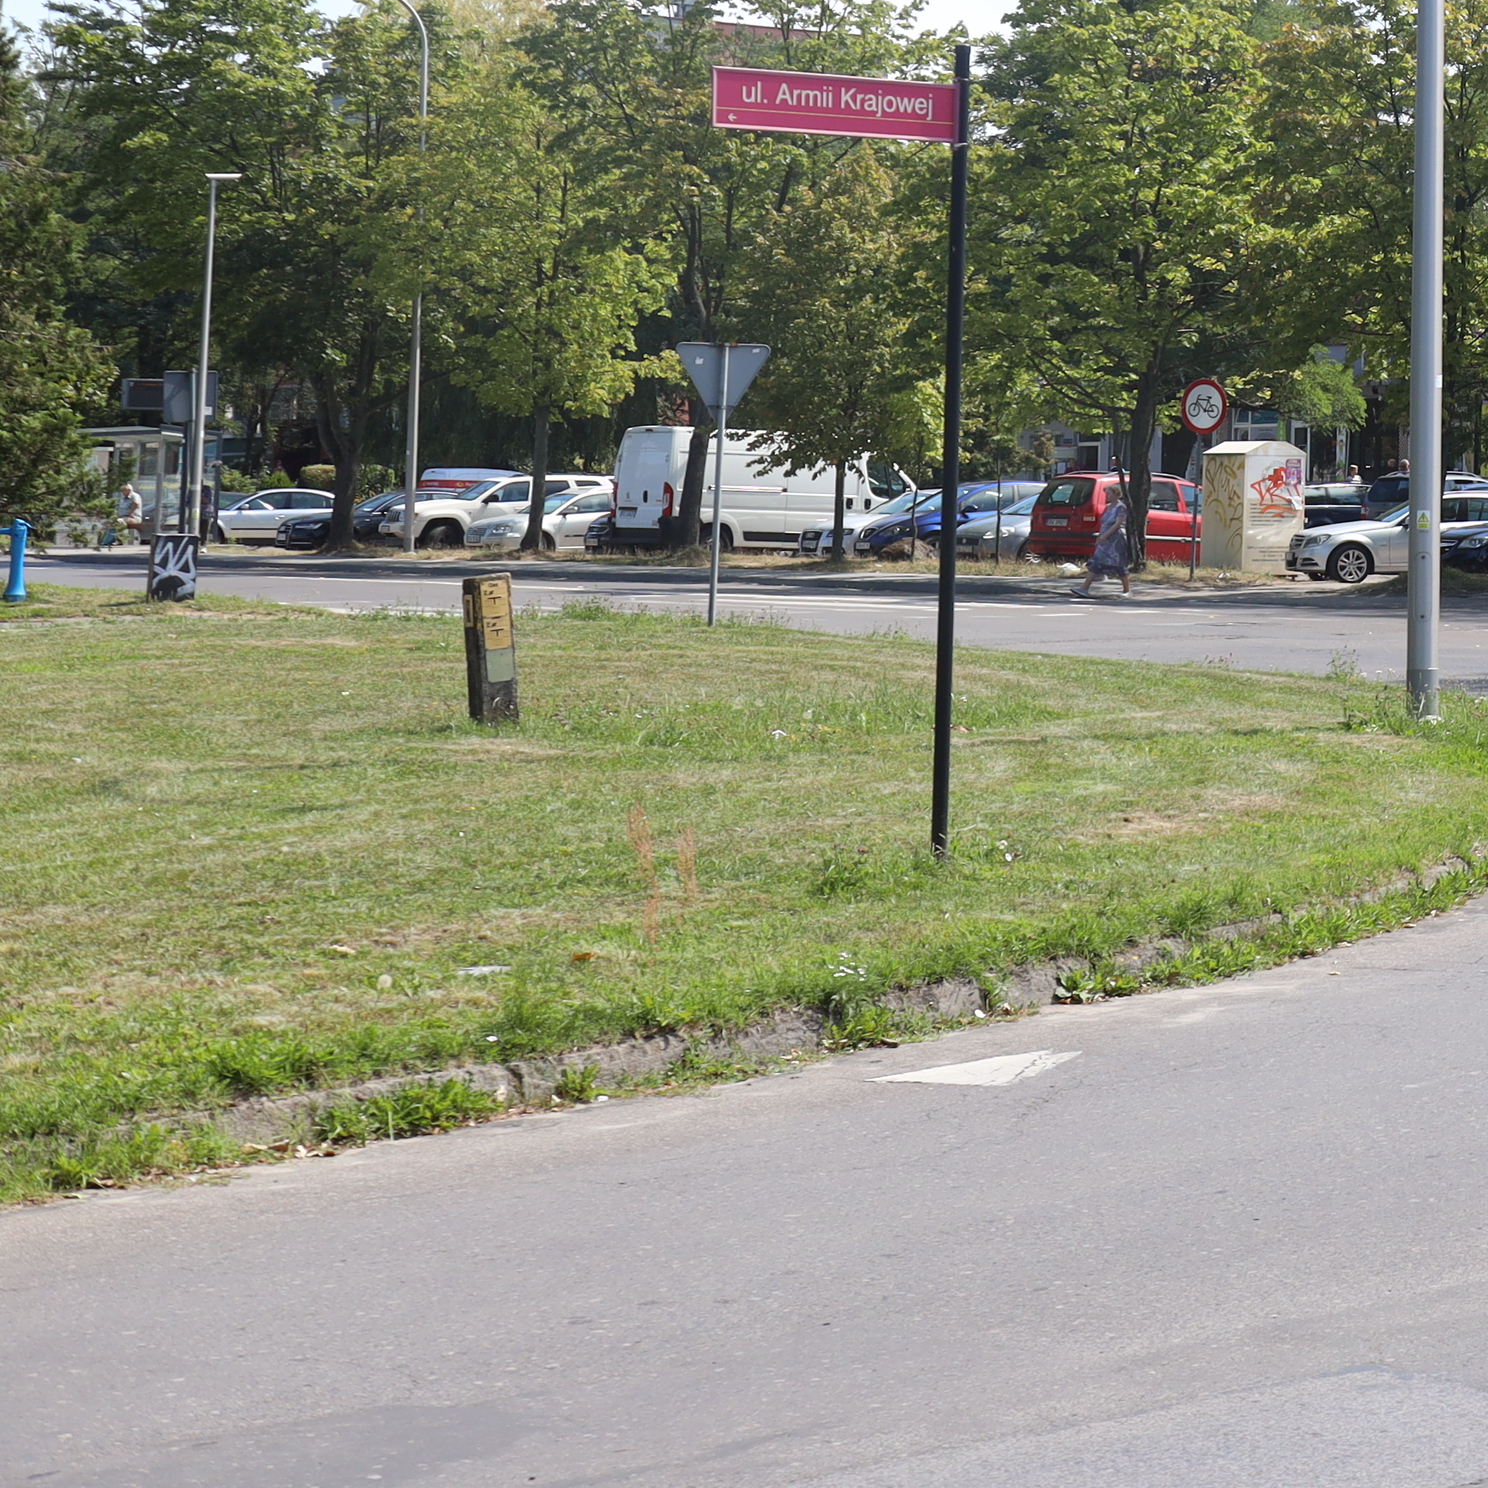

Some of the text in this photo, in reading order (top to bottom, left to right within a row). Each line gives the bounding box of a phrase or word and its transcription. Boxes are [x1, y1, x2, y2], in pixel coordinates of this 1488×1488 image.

[742, 81, 933, 121] ul. Armii Krajowej
